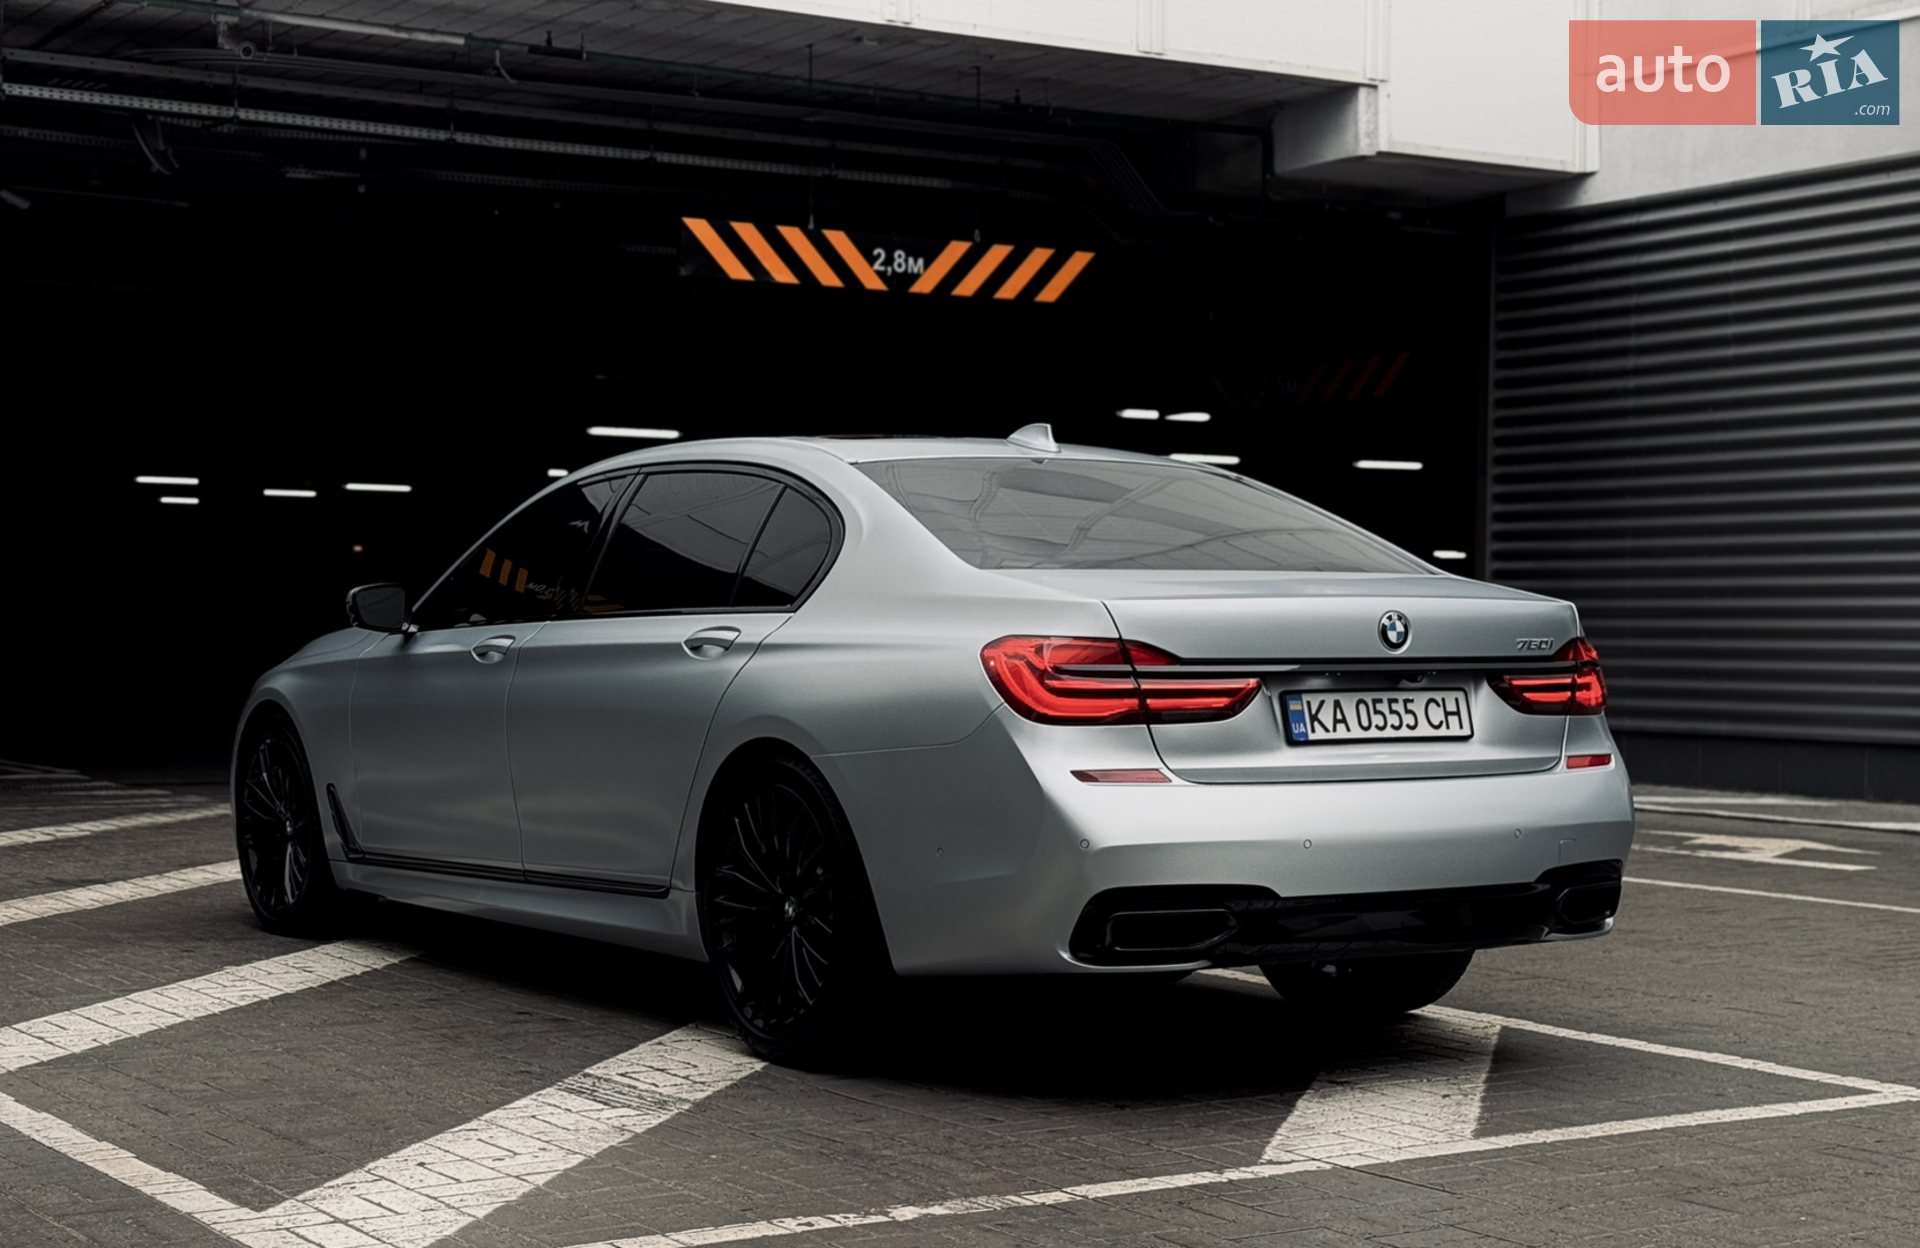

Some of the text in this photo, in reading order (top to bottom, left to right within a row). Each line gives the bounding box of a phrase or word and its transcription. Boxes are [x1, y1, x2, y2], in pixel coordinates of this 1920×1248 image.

[1306, 697, 1464, 733] KA 0555 CH
[1292, 722, 1307, 734] UA
